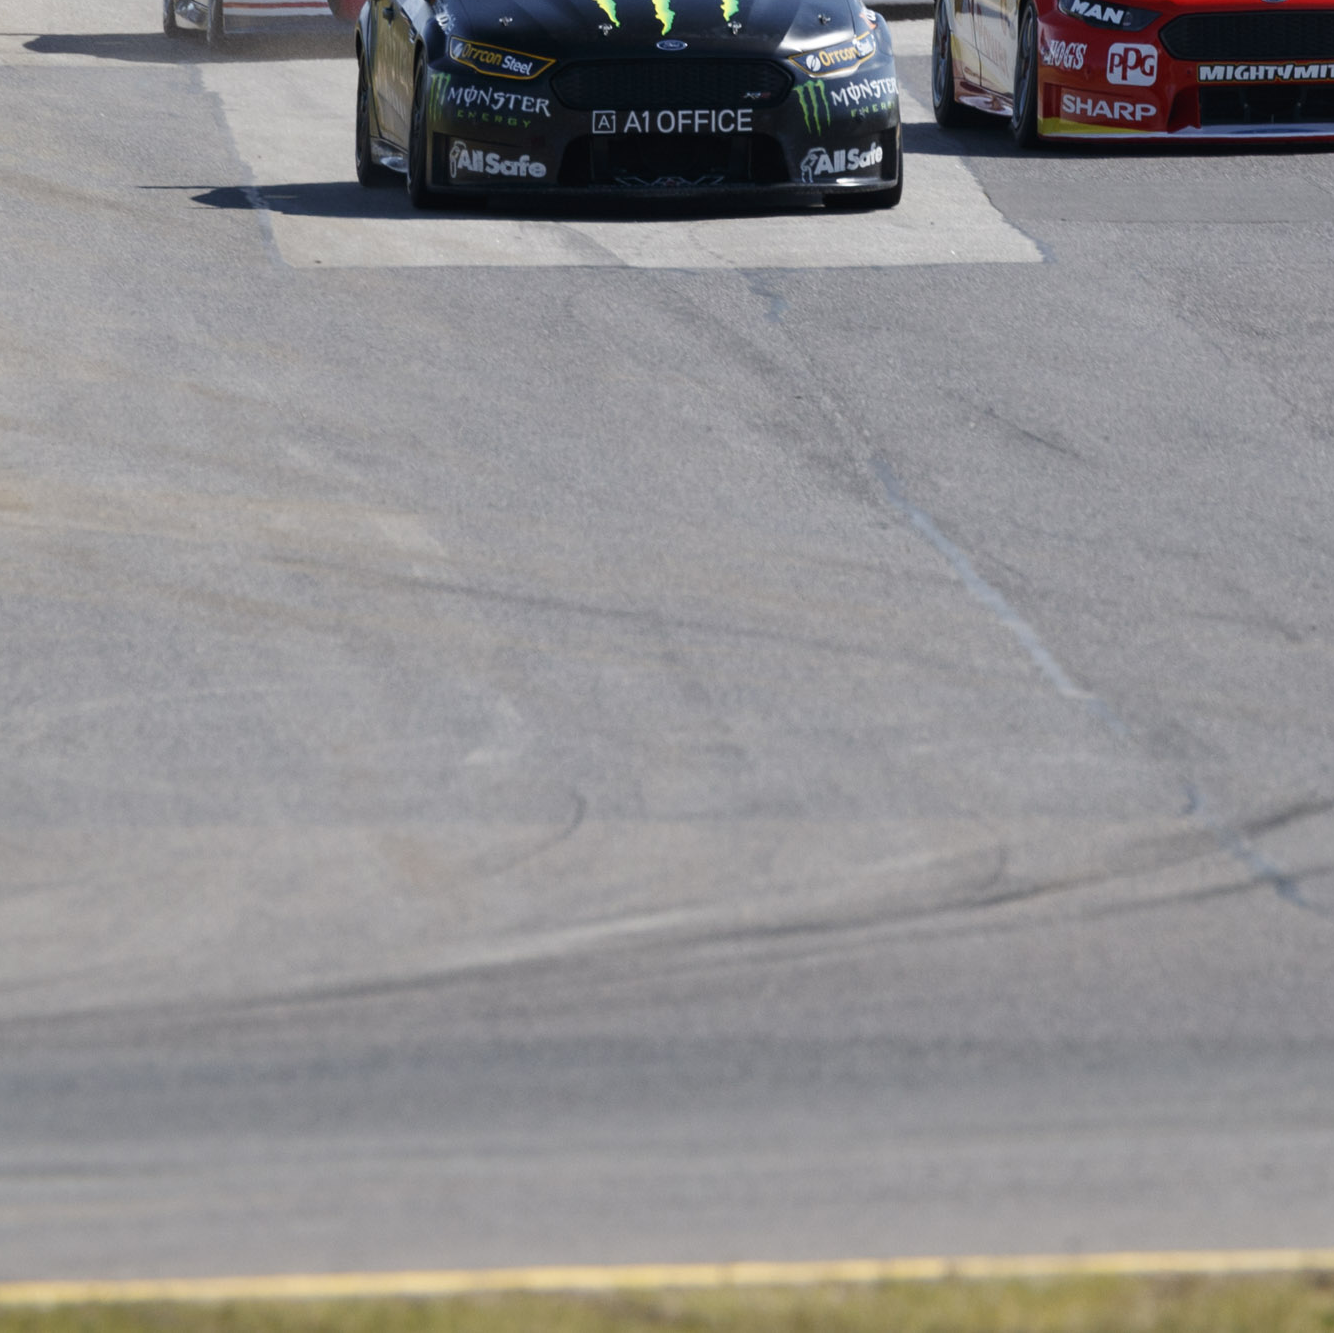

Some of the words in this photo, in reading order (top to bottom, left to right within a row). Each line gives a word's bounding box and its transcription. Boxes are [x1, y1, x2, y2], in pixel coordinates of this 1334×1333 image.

[501, 54, 533, 76] Steel
[1108, 47, 1156, 82] PPG
[1061, 93, 1157, 122] SHARP
[456, 148, 547, 179] AllSafe
[814, 142, 884, 176] AllSafe
